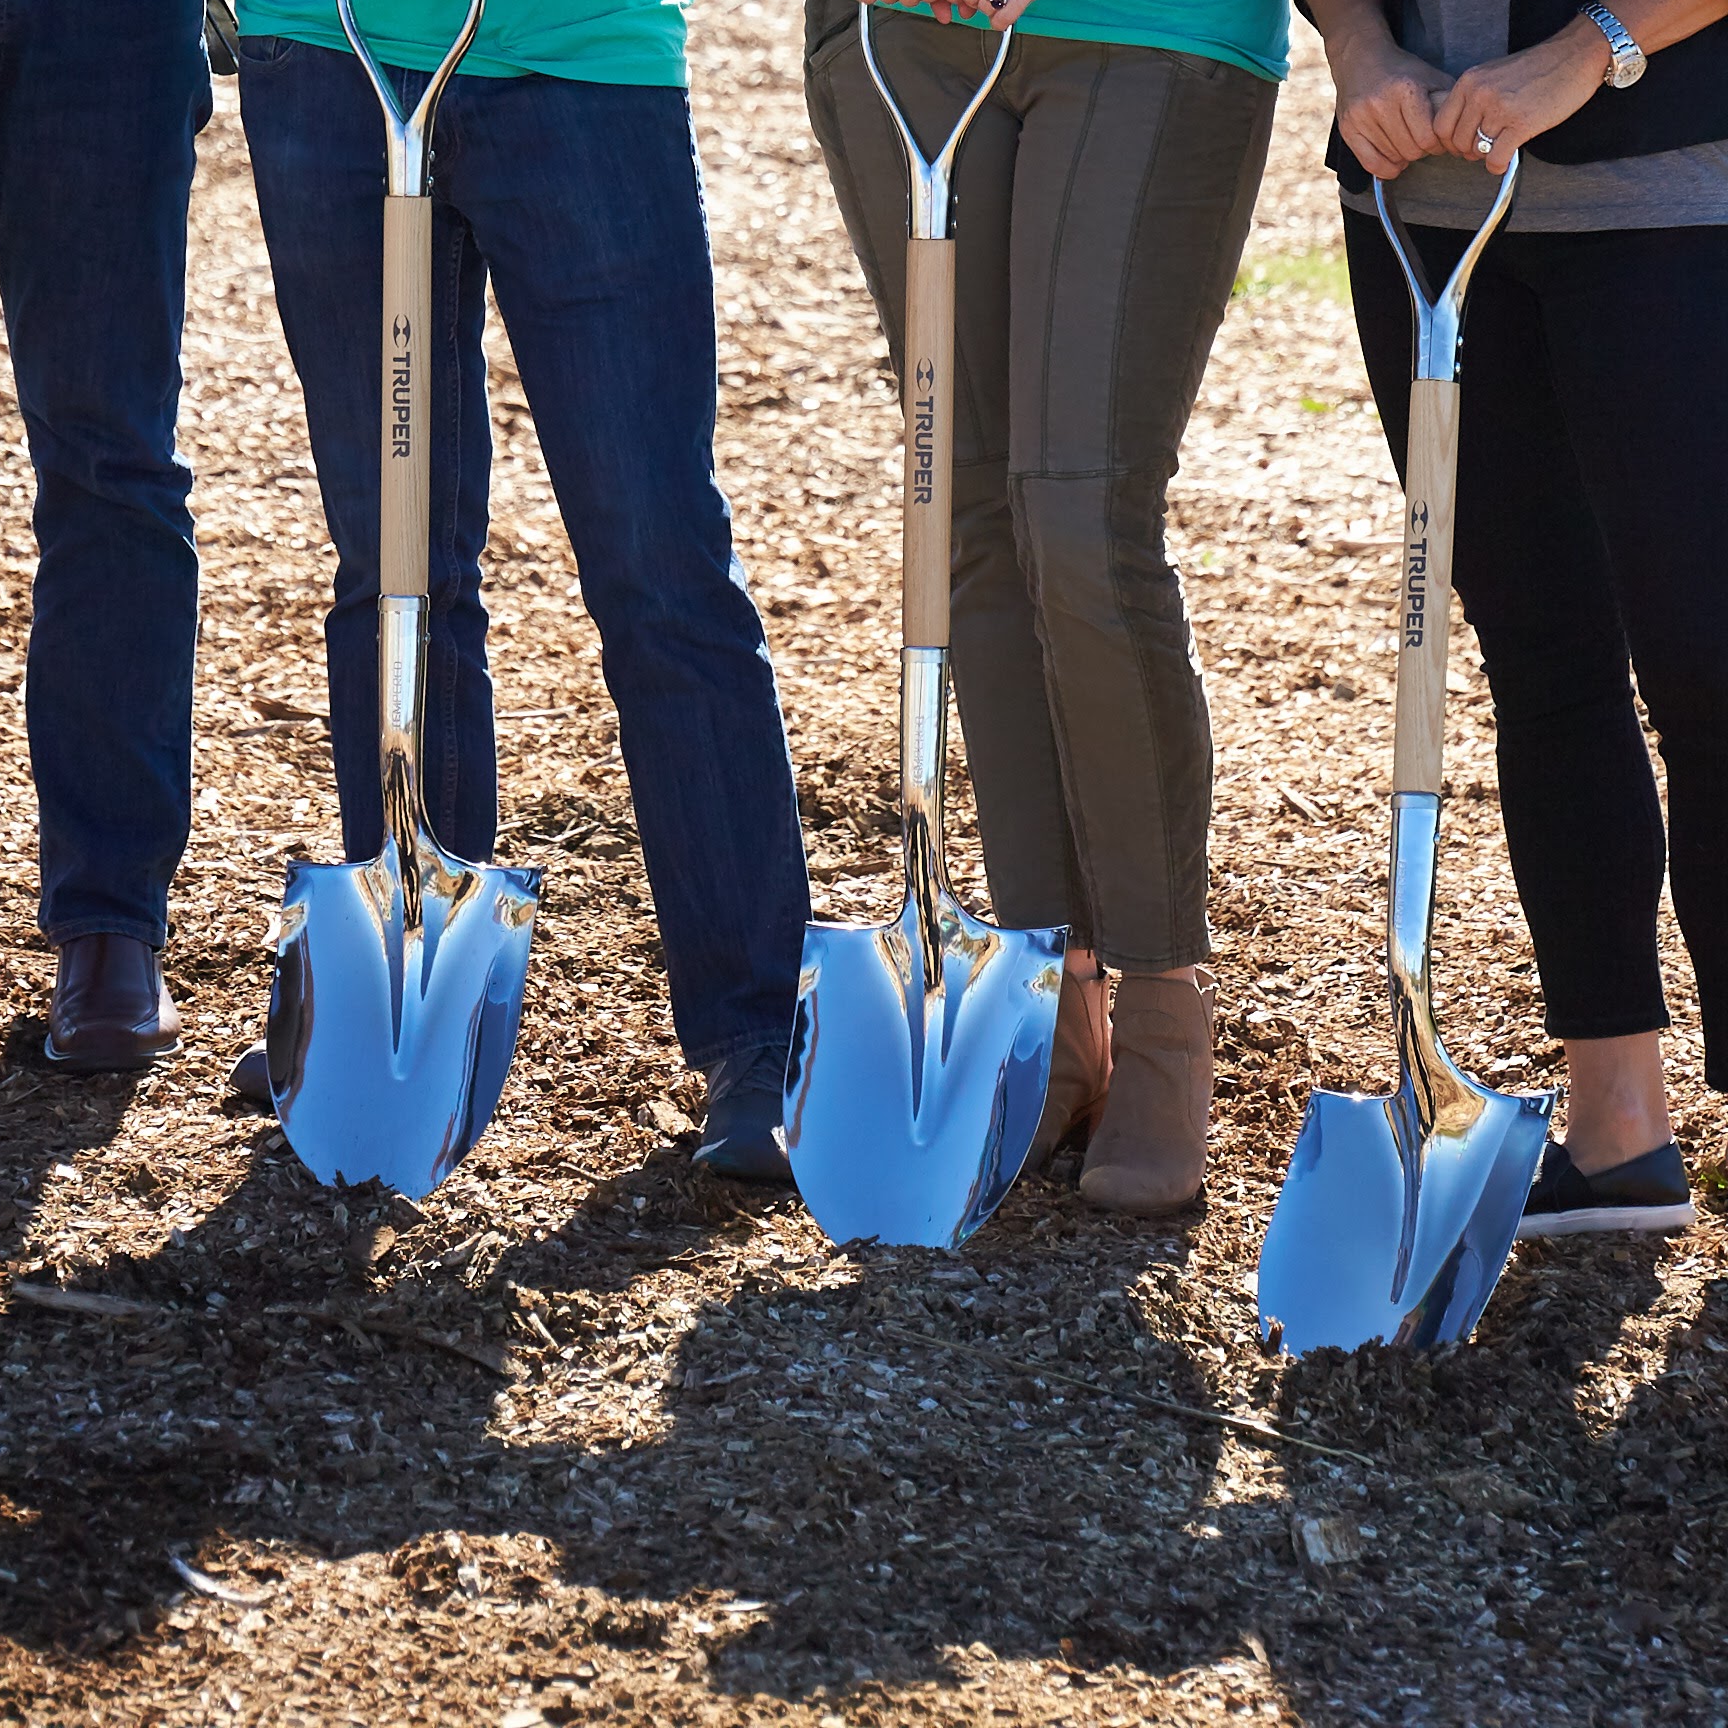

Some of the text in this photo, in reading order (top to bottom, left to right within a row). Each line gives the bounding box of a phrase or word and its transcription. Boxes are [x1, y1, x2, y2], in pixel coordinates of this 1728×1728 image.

[392, 351, 411, 459] TRUPER
[913, 395, 934, 506] TRUPER
[1404, 537, 1427, 650] TRUPER
